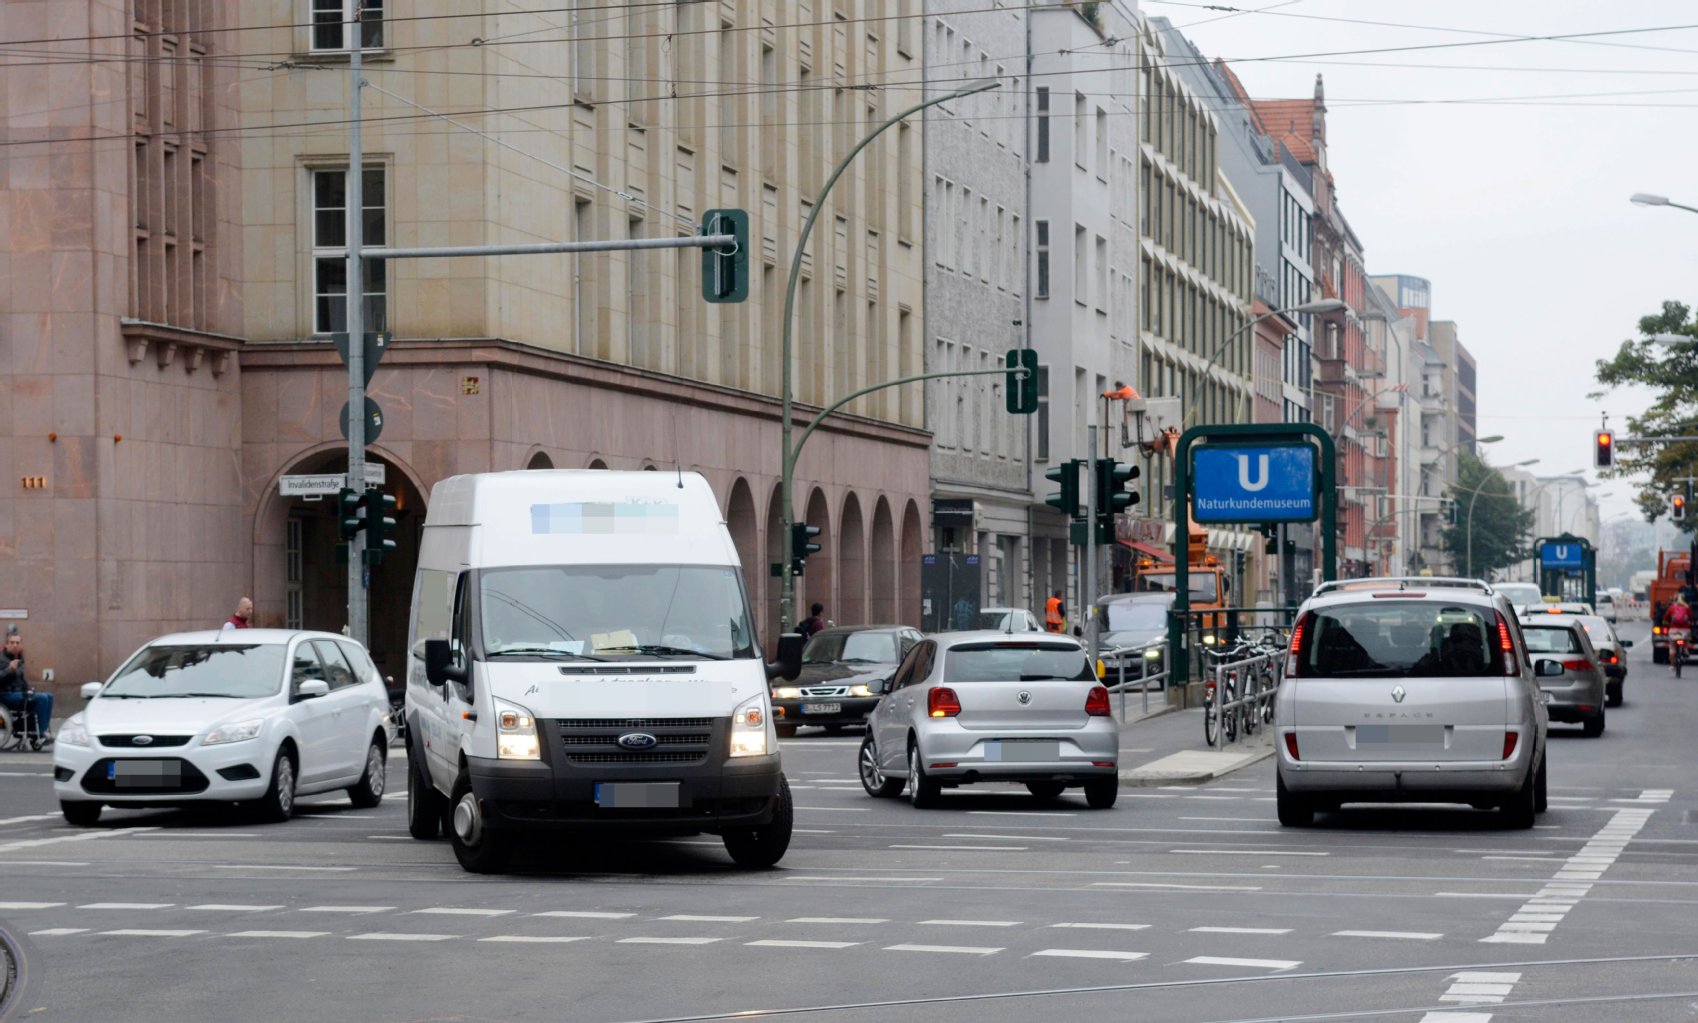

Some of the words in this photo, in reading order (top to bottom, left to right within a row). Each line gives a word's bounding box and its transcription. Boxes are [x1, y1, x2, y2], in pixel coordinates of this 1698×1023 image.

[1238, 454, 1269, 492] U
[21, 476, 46, 489] 111
[288, 478, 339, 490] Invalidenstraße
[1198, 497, 1311, 509] Naturkundemuseum
[1555, 545, 1568, 560] U
[627, 735, 648, 745] Ford
